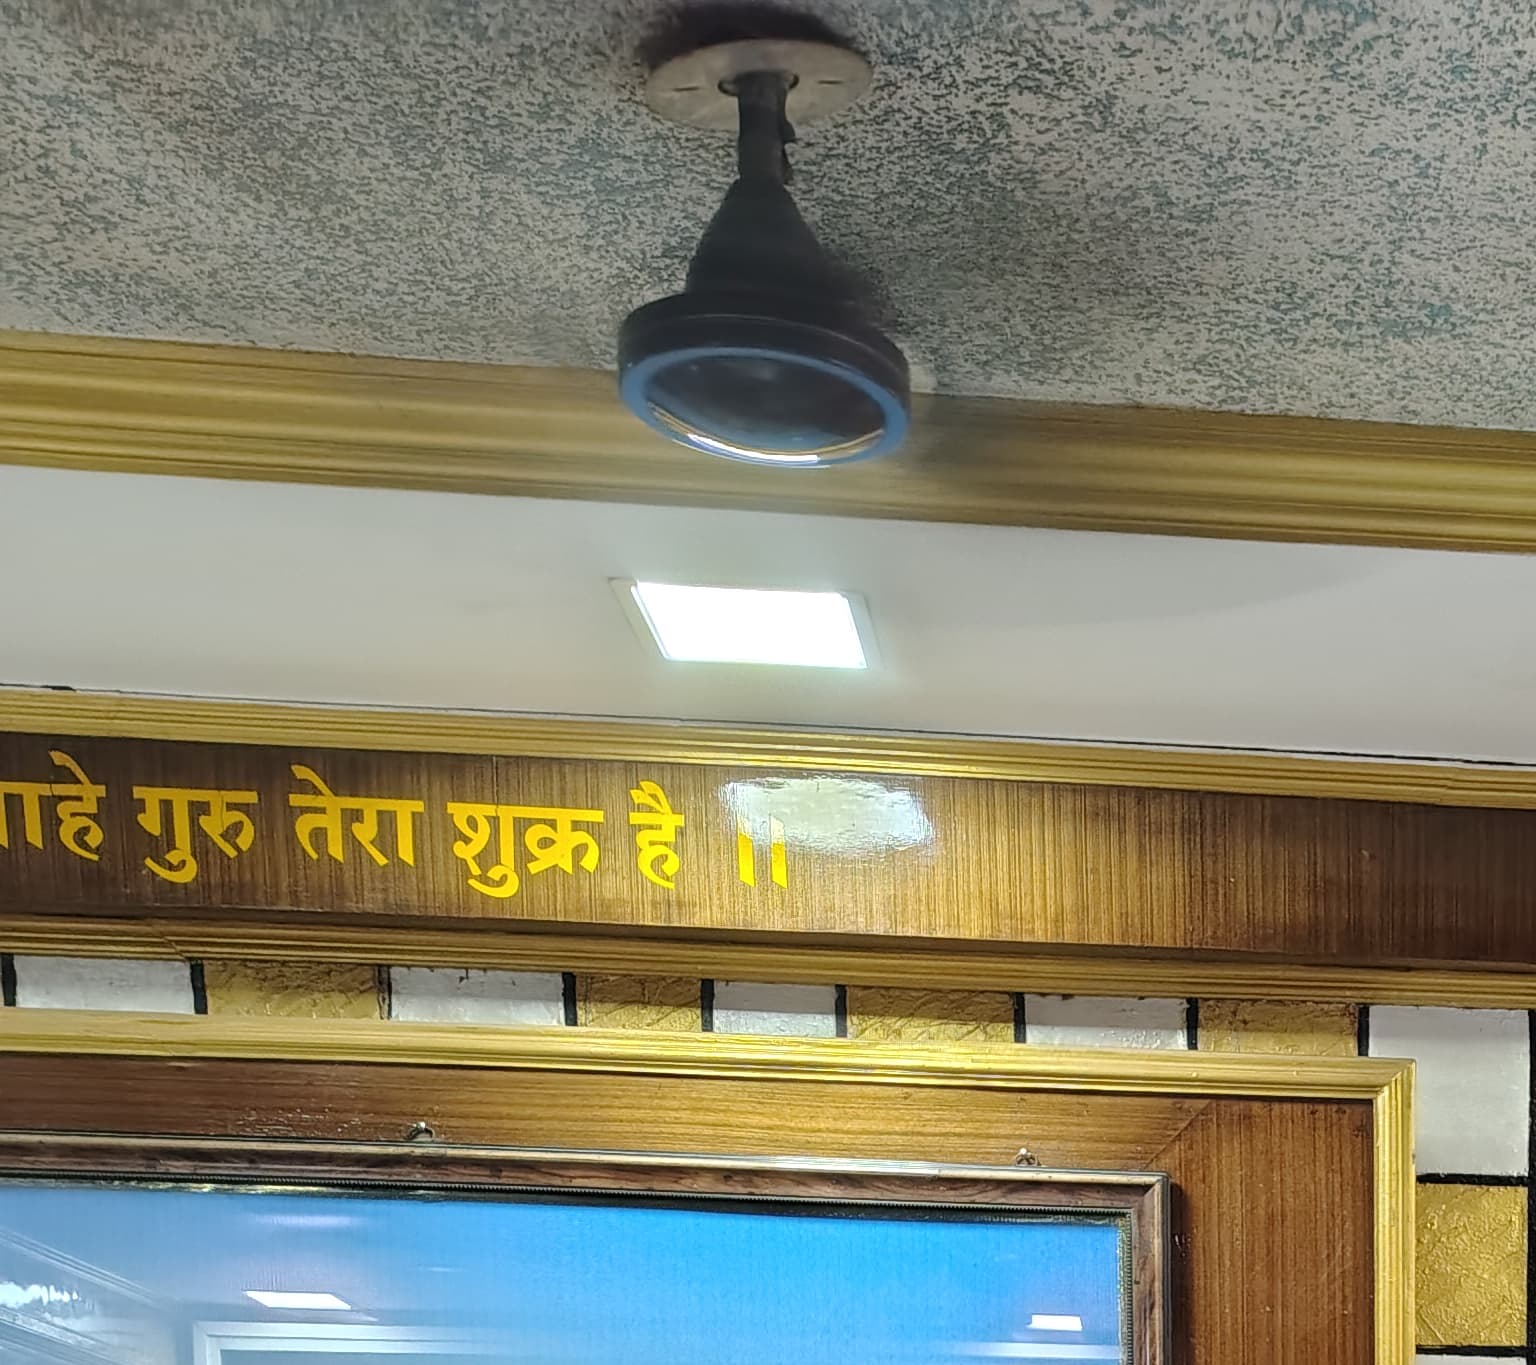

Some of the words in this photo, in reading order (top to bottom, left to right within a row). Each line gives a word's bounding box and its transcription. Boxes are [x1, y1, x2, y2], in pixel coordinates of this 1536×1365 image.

[133, 786, 259, 883] गुरु
[290, 764, 424, 868] तेरा
[448, 800, 604, 899] शुक्र
[629, 781, 684, 889] है
